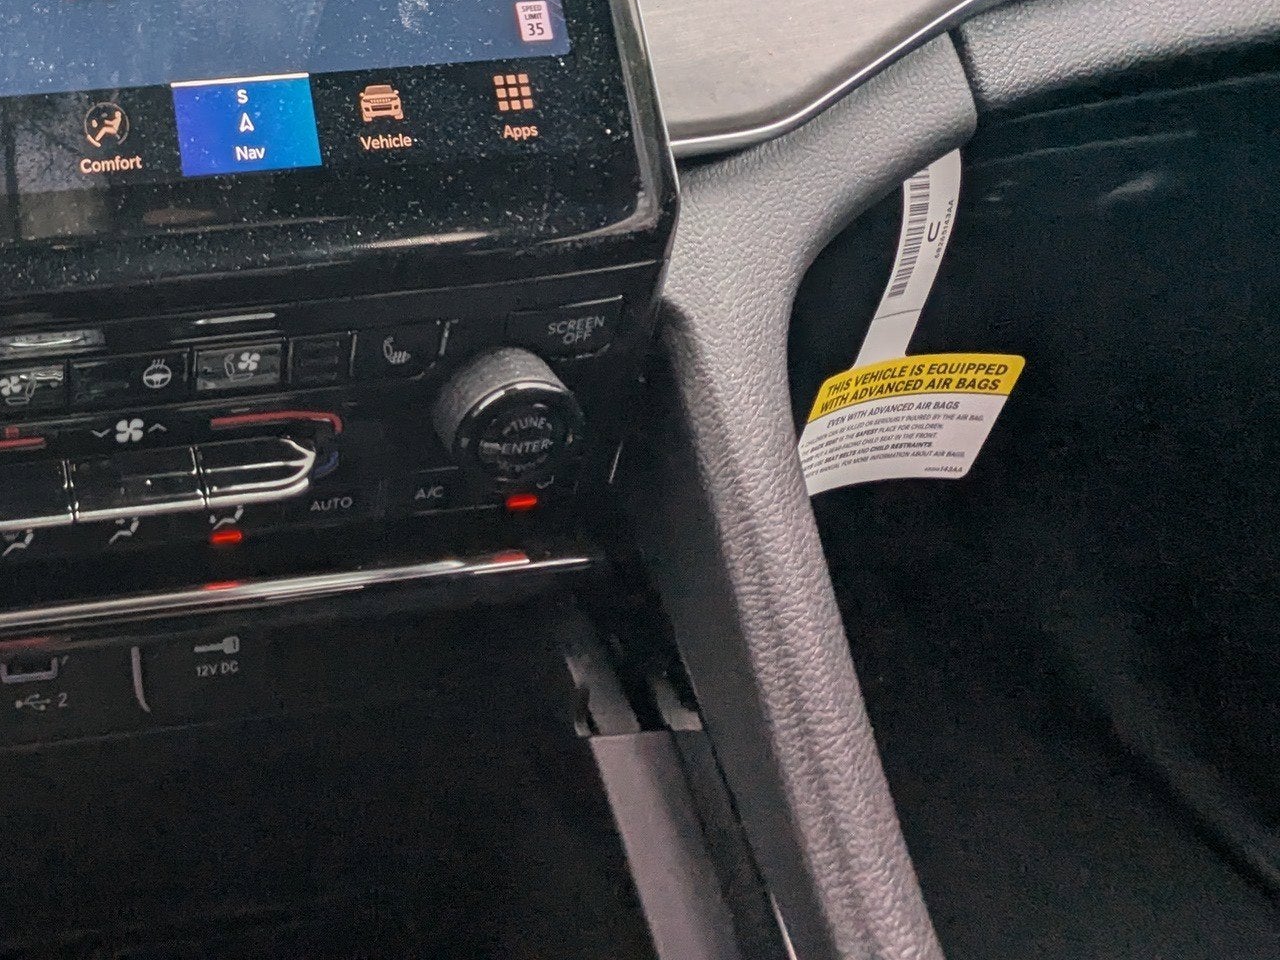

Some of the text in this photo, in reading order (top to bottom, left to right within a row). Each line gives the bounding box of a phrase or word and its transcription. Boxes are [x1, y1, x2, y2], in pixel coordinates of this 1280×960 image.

[521, 4, 542, 13] SPEED
[524, 12, 542, 21] LIMIT
[527, 22, 545, 36] 35
[237, 89, 248, 104] S
[503, 122, 539, 142] Apps
[360, 132, 412, 151] Vehicle
[235, 144, 266, 162] Nav
[80, 154, 143, 173] Comfort
[548, 315, 606, 335] SCREEN
[562, 328, 593, 345] OFF
[826, 362, 1008, 398] THIS VEHICLE IS EQUIPPED
[820, 377, 1001, 414] WITH ADVANCED AIR BAGS
[511, 416, 547, 431] TUNE
[826, 401, 961, 429] EVEN WITH ADVANCED AIR BAGS
[500, 437, 550, 455] ENTER
[413, 485, 445, 501] A/C
[310, 495, 353, 511] AUTO
[195, 661, 240, 677] 12V DC
[58, 692, 68, 709] 2
